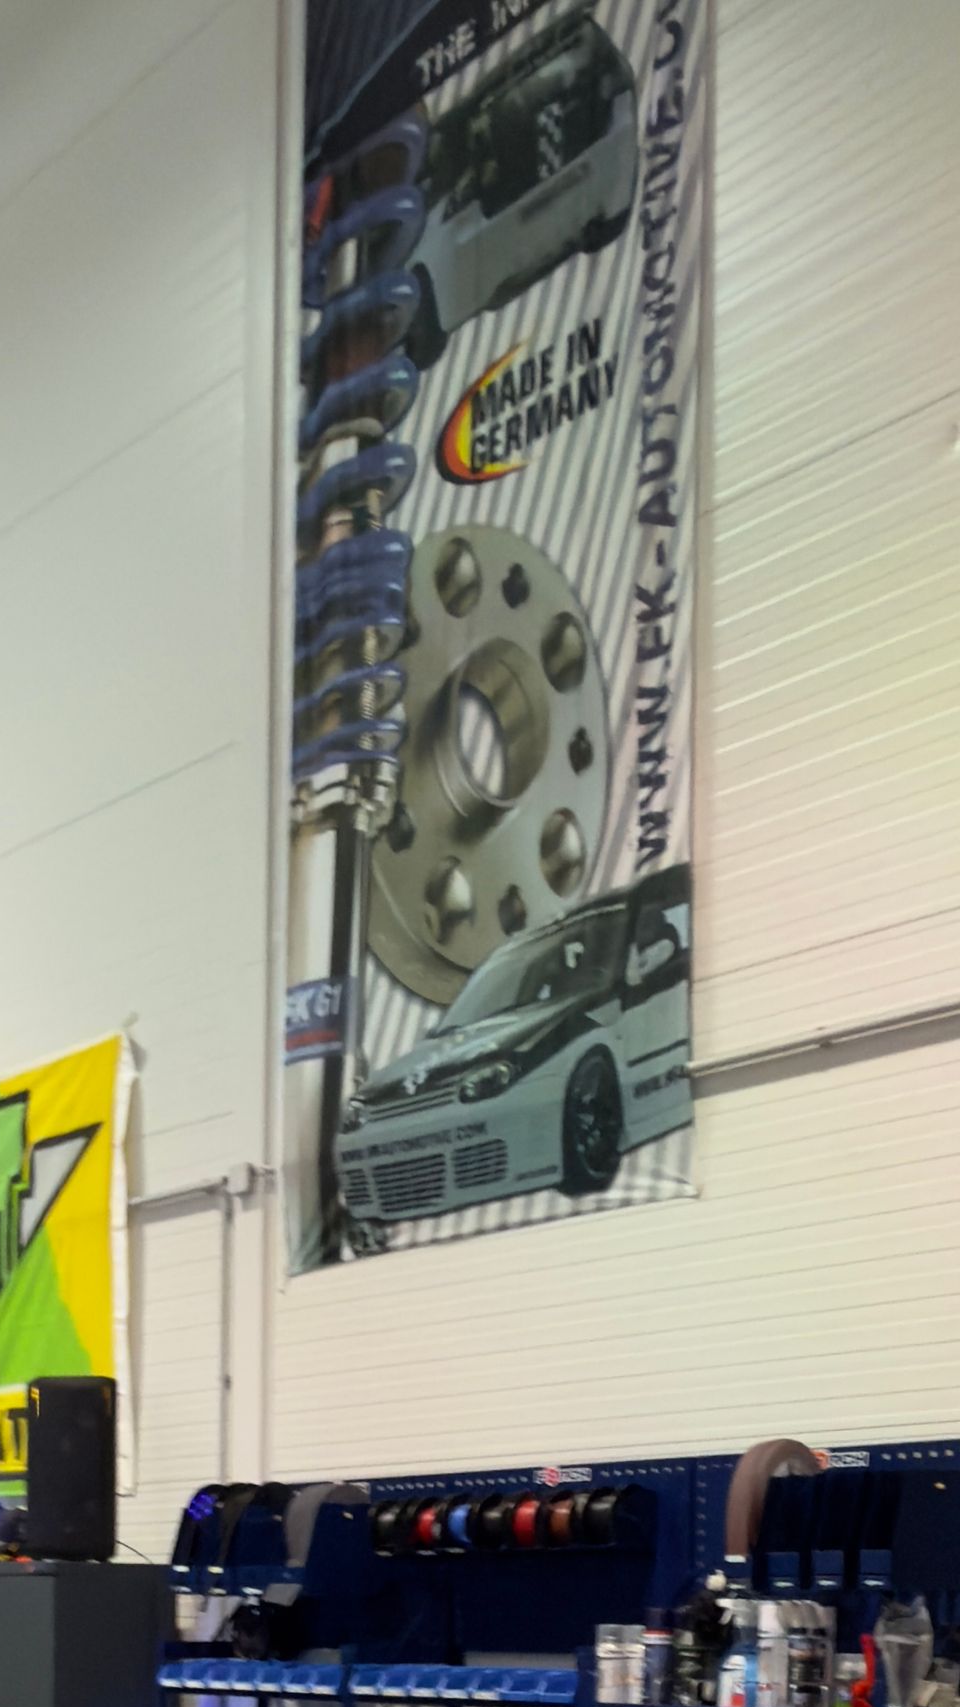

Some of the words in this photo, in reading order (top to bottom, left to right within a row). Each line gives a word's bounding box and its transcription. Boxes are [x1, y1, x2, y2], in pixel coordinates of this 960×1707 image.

[416, 18, 477, 89] THE
[470, 343, 554, 432] MADE
[567, 318, 601, 374] IN
[470, 352, 619, 475] GERMANY
